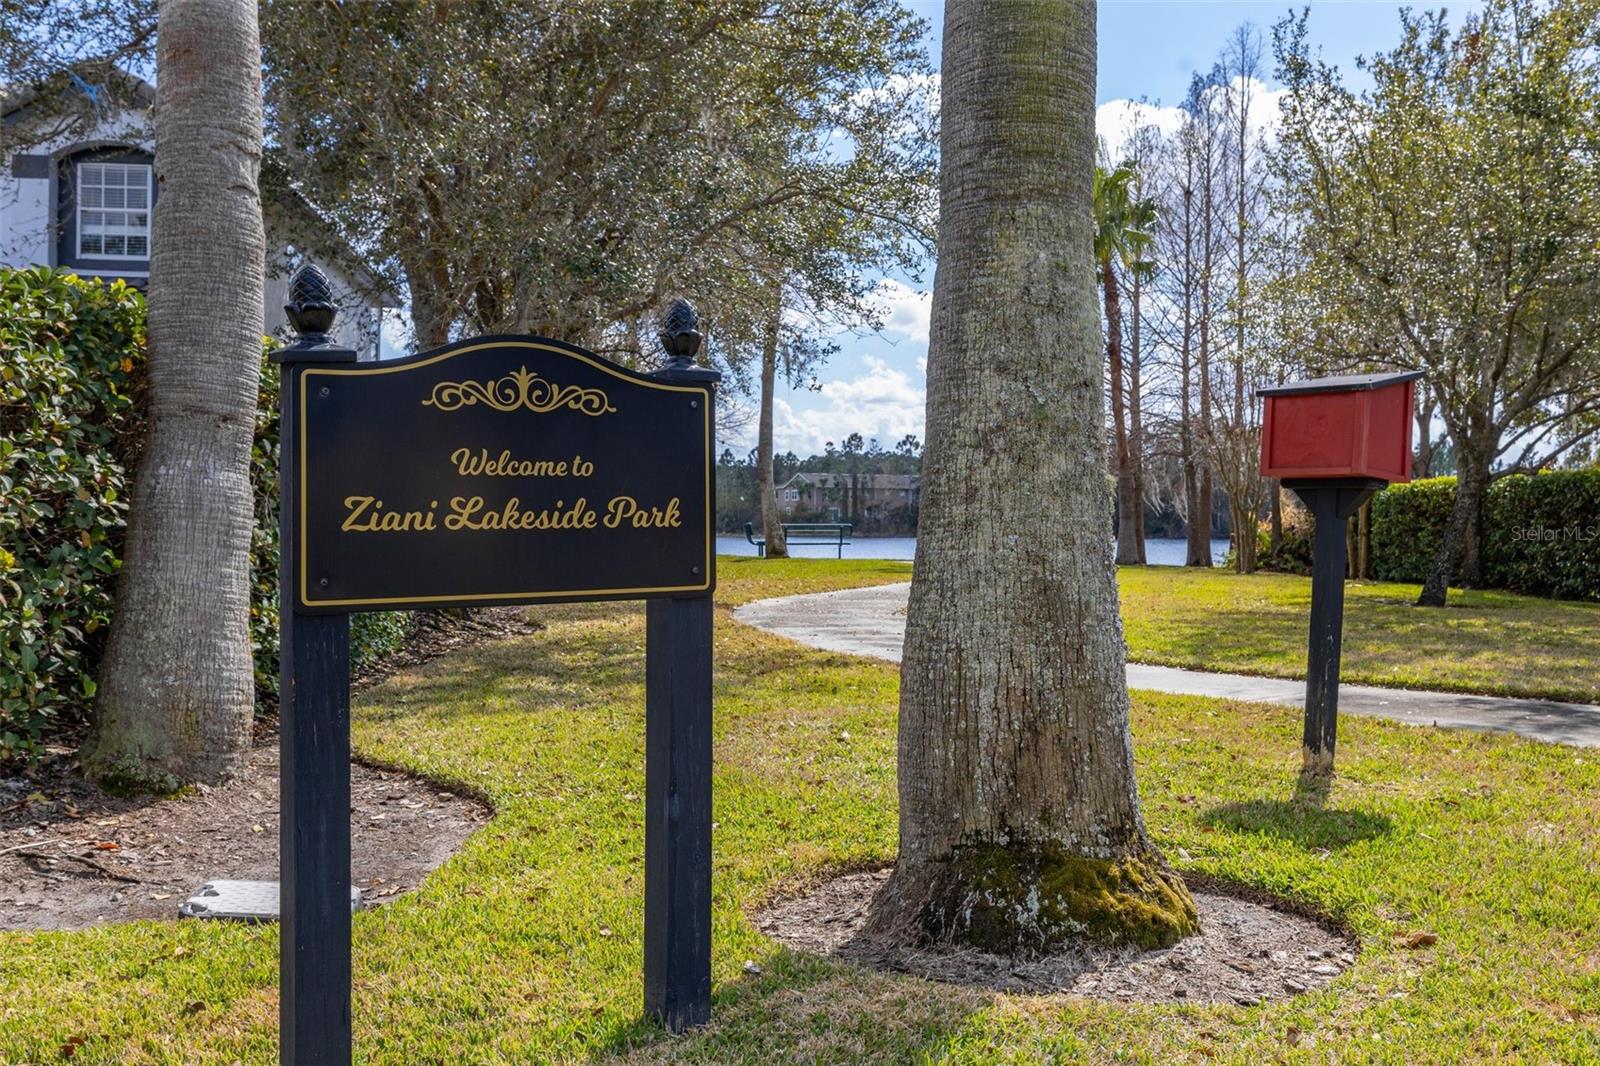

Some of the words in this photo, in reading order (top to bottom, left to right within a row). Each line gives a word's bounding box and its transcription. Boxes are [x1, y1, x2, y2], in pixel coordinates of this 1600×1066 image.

[450, 447, 568, 477] Welcome
[572, 456, 594, 477] to
[341, 496, 438, 532] Ziani
[444, 496, 597, 531] Lakeside
[603, 496, 681, 529] Park
